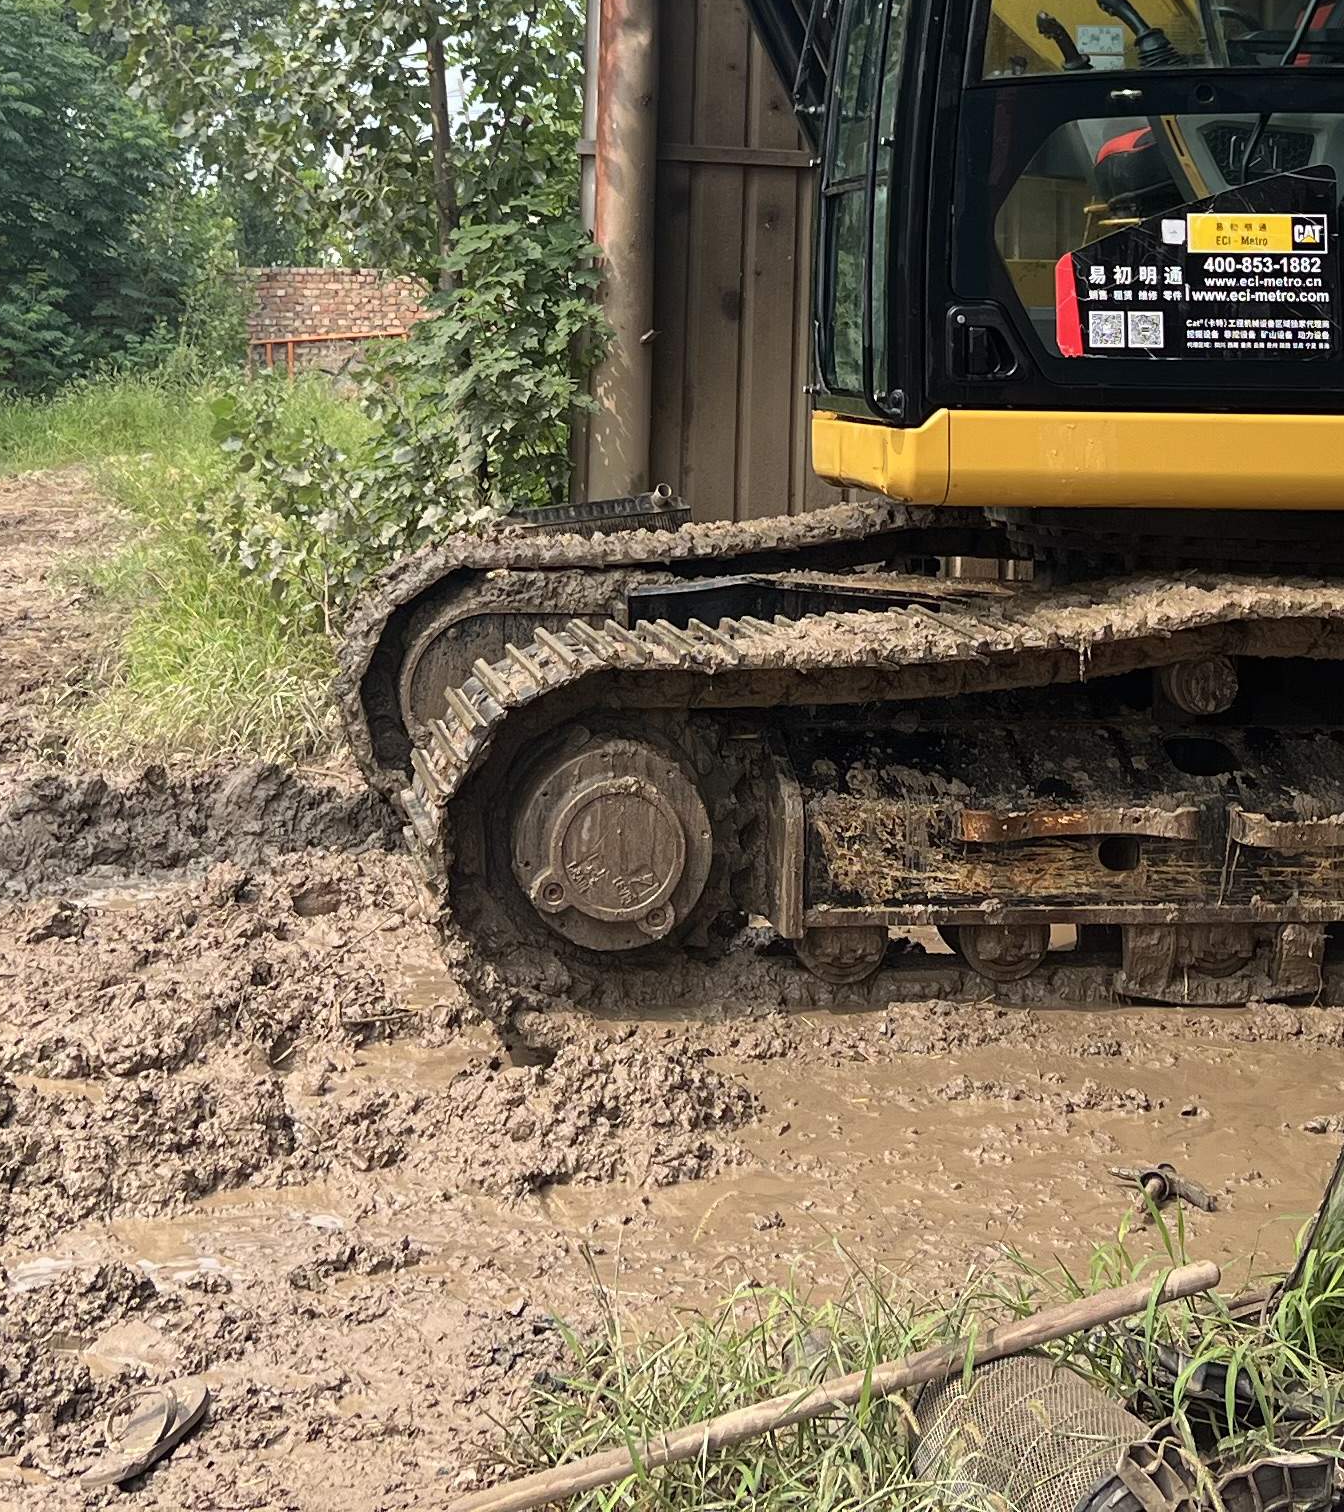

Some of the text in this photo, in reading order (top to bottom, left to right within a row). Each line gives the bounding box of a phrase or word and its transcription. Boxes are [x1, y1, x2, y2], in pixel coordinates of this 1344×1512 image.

[1294, 224, 1323, 243] CAT
[1203, 257, 1322, 273] 400-853-1882
[1089, 265, 1183, 285] 易初明通
[1204, 276, 1322, 287] www.eci-metro.cn
[1192, 289, 1330, 303] www.eci-metro.com
